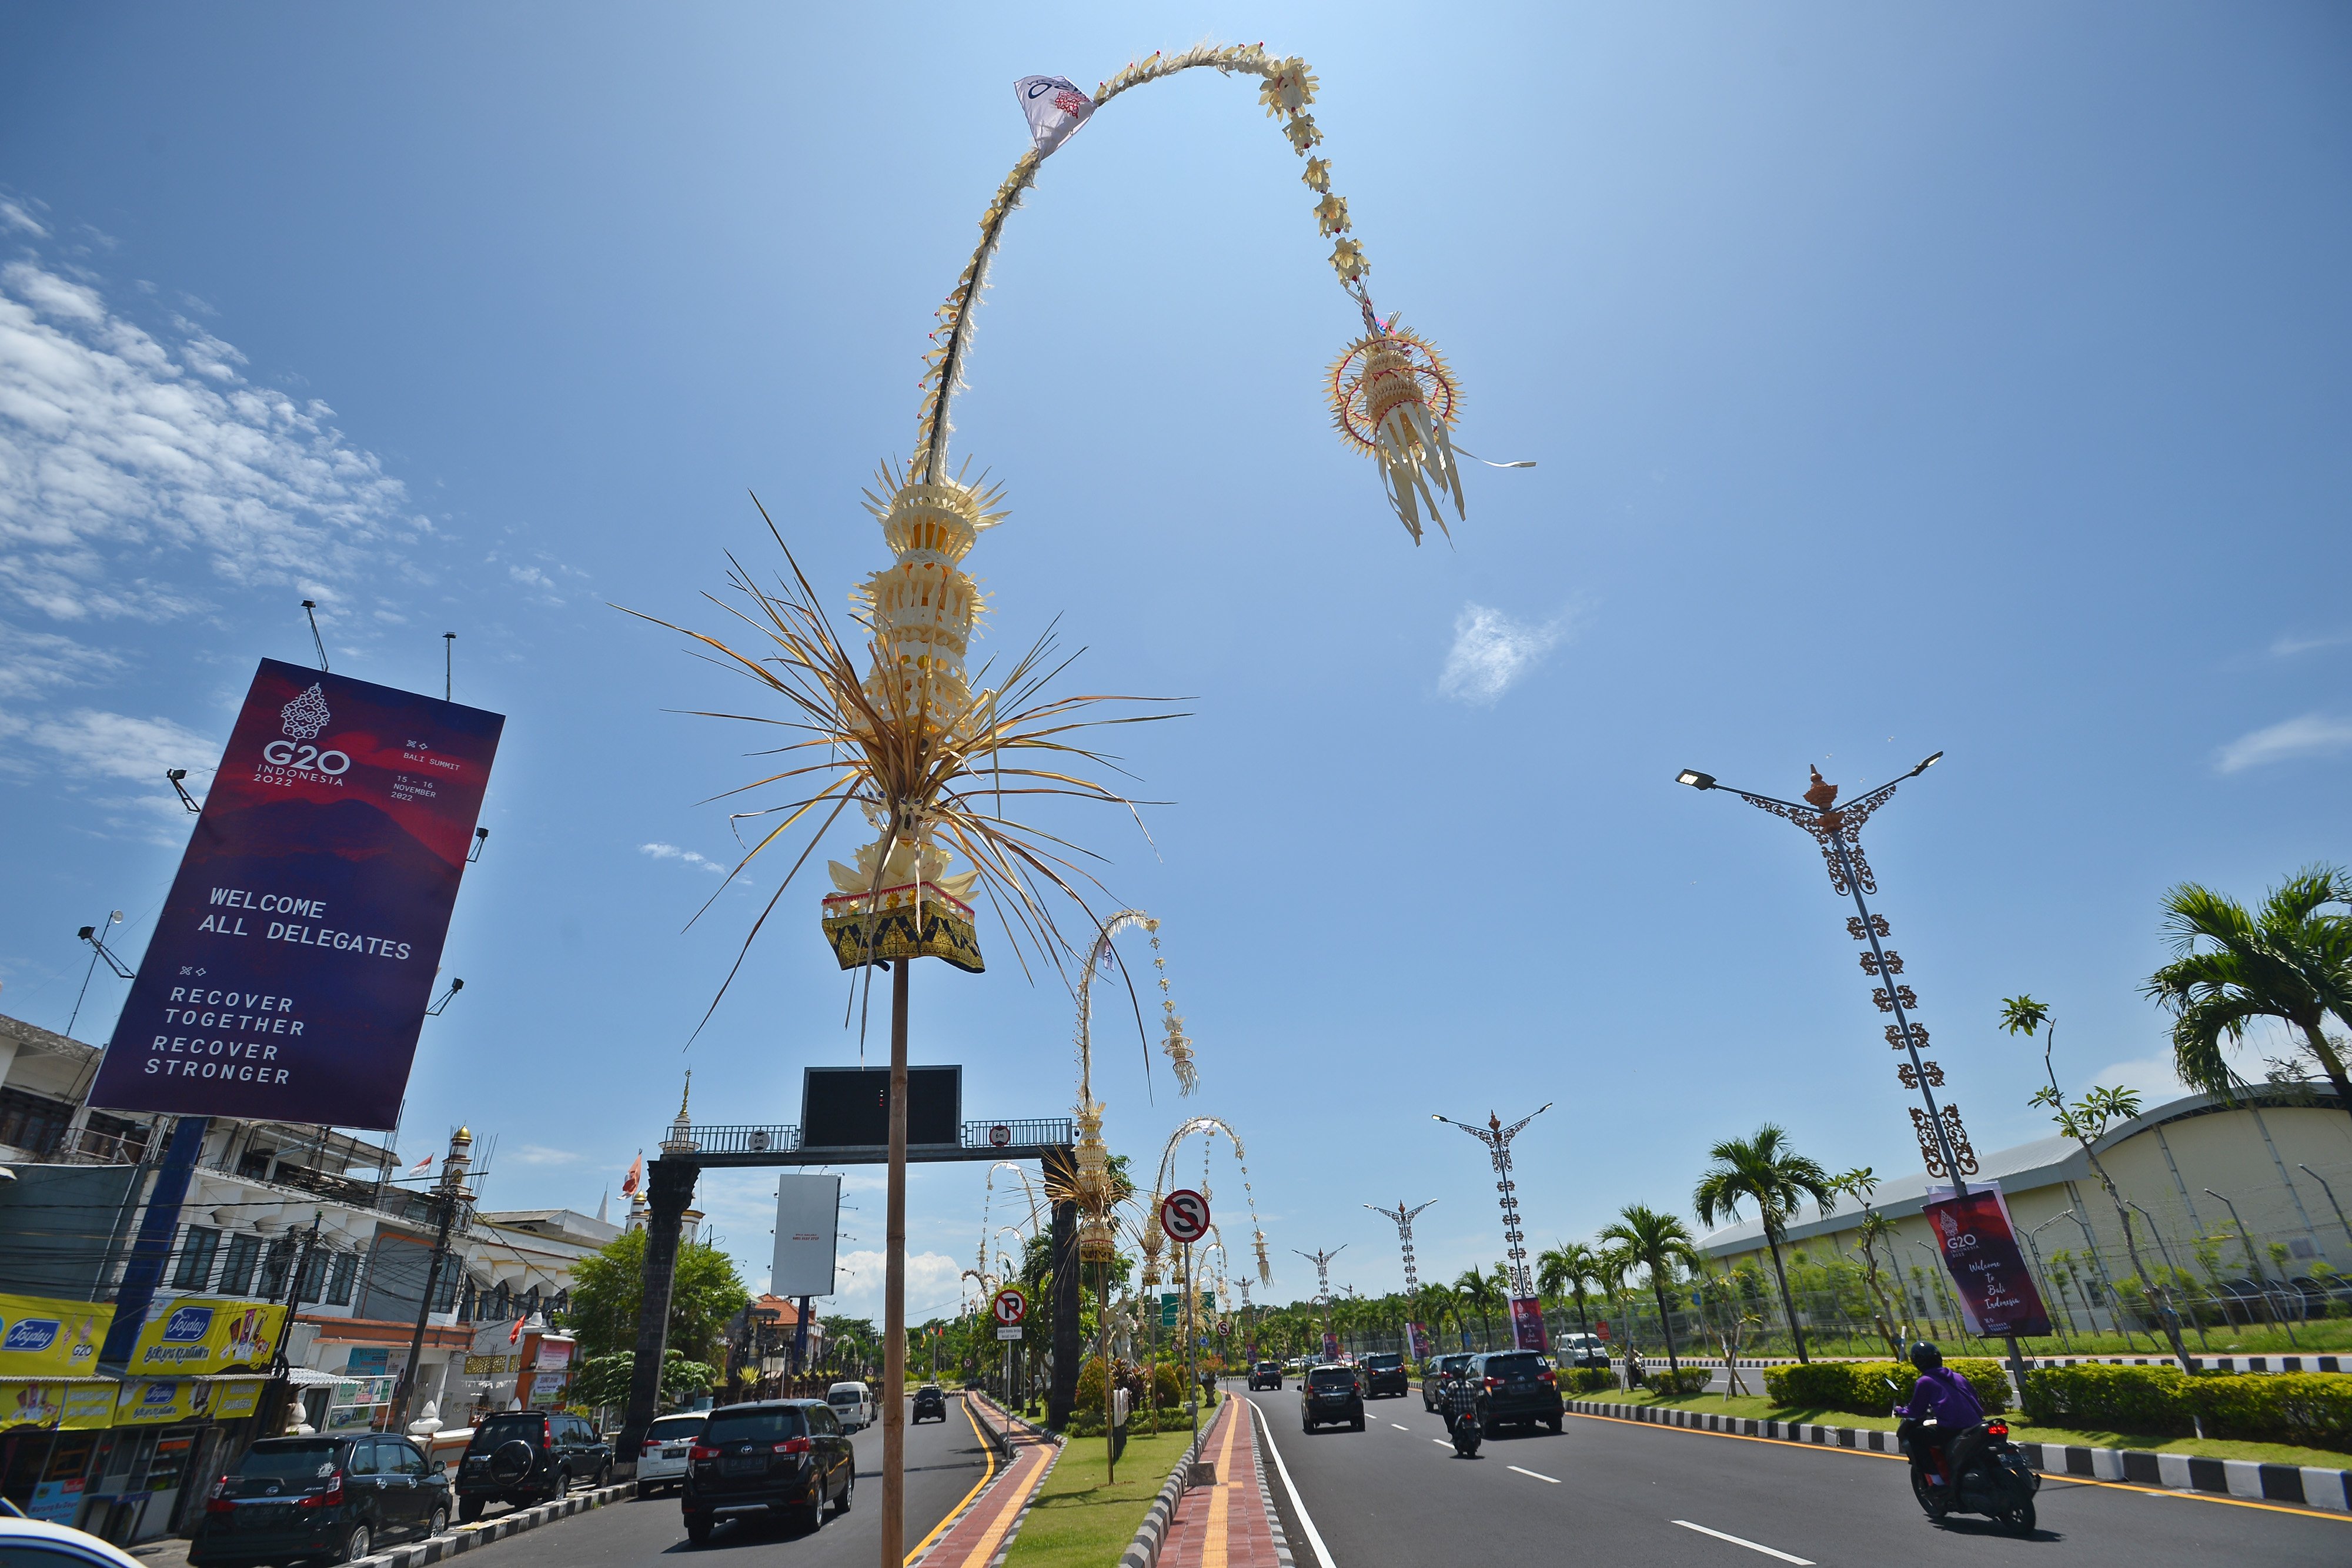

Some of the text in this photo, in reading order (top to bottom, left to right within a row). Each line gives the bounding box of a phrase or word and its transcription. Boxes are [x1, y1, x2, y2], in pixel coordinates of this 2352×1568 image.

[263, 740, 350, 775] G20
[403, 753, 460, 770] BALI SUMMIT
[253, 774, 292, 787] 2022
[257, 764, 343, 787] INDONESIA
[391, 791, 413, 801] 2022
[393, 783, 436, 798] NOVEMBER
[209, 887, 326, 918] WELCOME
[198, 914, 411, 960] ALL DELEGATES
[169, 987, 292, 1012] RECOVER
[165, 1008, 304, 1036] TOGETHER
[152, 1035, 278, 1061] RECOVER
[144, 1058, 289, 1084] STRONGER
[1172, 1198, 1198, 1232] S
[1947, 1234, 1976, 1249] G20
[1950, 1245, 1980, 1254] INDONESIA
[1969, 1259, 2000, 1273] Welcome
[1984, 1272, 1994, 1283] to
[1987, 1283, 2006, 1296] Bali
[1004, 1298, 1019, 1318] P
[1984, 1297, 2020, 1309] Indonesia
[168, 1315, 205, 1337] Joyday
[1220, 1324, 1227, 1333] S
[9, 1325, 53, 1347] Joyday
[72, 1345, 93, 1356] G20
